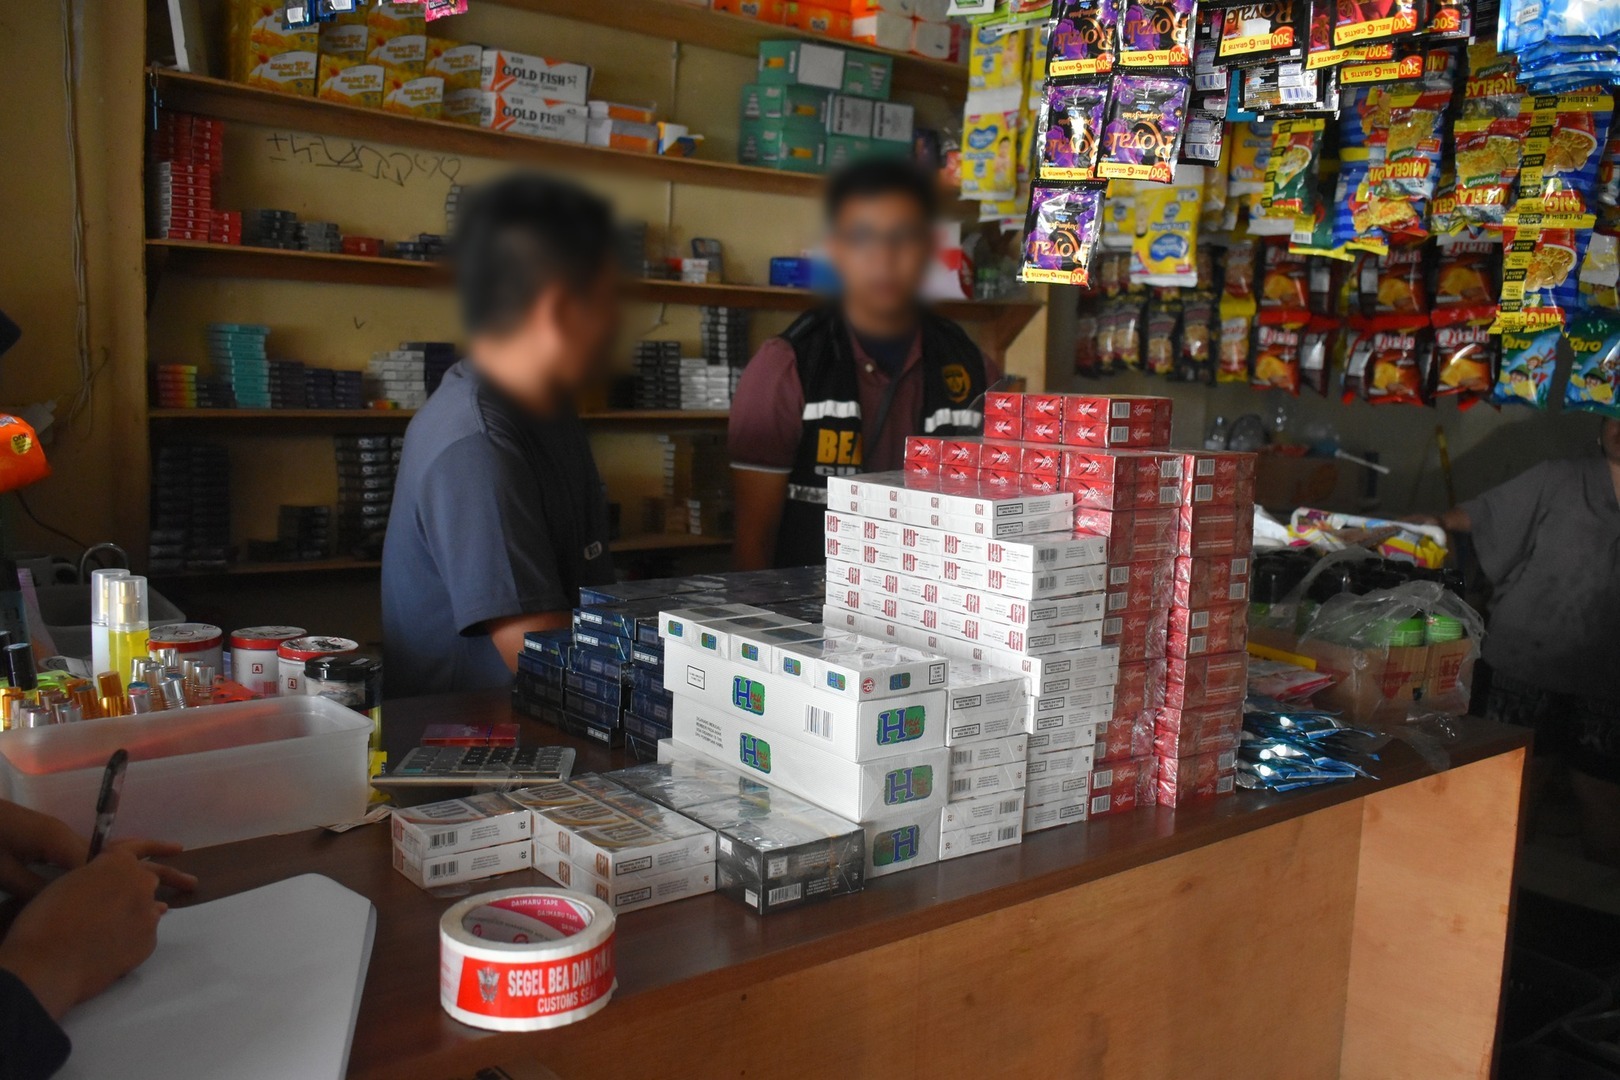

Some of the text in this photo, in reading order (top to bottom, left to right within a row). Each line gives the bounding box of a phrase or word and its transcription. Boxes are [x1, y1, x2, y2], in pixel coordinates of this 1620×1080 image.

[1226, 0, 1294, 30] Royale
[1394, 16, 1413, 30] 500
[1433, 16, 1455, 29] 500
[1344, 28, 1366, 36] GRATIS
[1367, 24, 1375, 35] 6
[1054, 18, 1114, 54] Royale
[1272, 34, 1290, 46] 500
[1336, 32, 1342, 41] 1
[1222, 44, 1226, 53] 1
[1229, 42, 1248, 50] GRATIS
[1249, 39, 1256, 49] 6
[1169, 52, 1185, 61] 500
[1342, 50, 1349, 58] 6
[1368, 45, 1388, 57] 500
[1148, 54, 1154, 62] 6
[1076, 62, 1082, 71] 6
[1400, 63, 1419, 75] 500
[503, 66, 537, 80] GOLD
[540, 72, 565, 85] FISH
[1343, 71, 1348, 80] 1
[1374, 67, 1382, 78] 6
[503, 106, 565, 126] GOLD FISH
[1104, 120, 1175, 158] Royale
[1100, 166, 1104, 174] 1
[1128, 167, 1134, 176] 6
[1151, 168, 1168, 179] 500
[508, 969, 545, 997] SEGEL
[548, 964, 569, 994] BEA
[572, 959, 592, 986] DAN
[538, 993, 578, 1013] CUSTOMS
